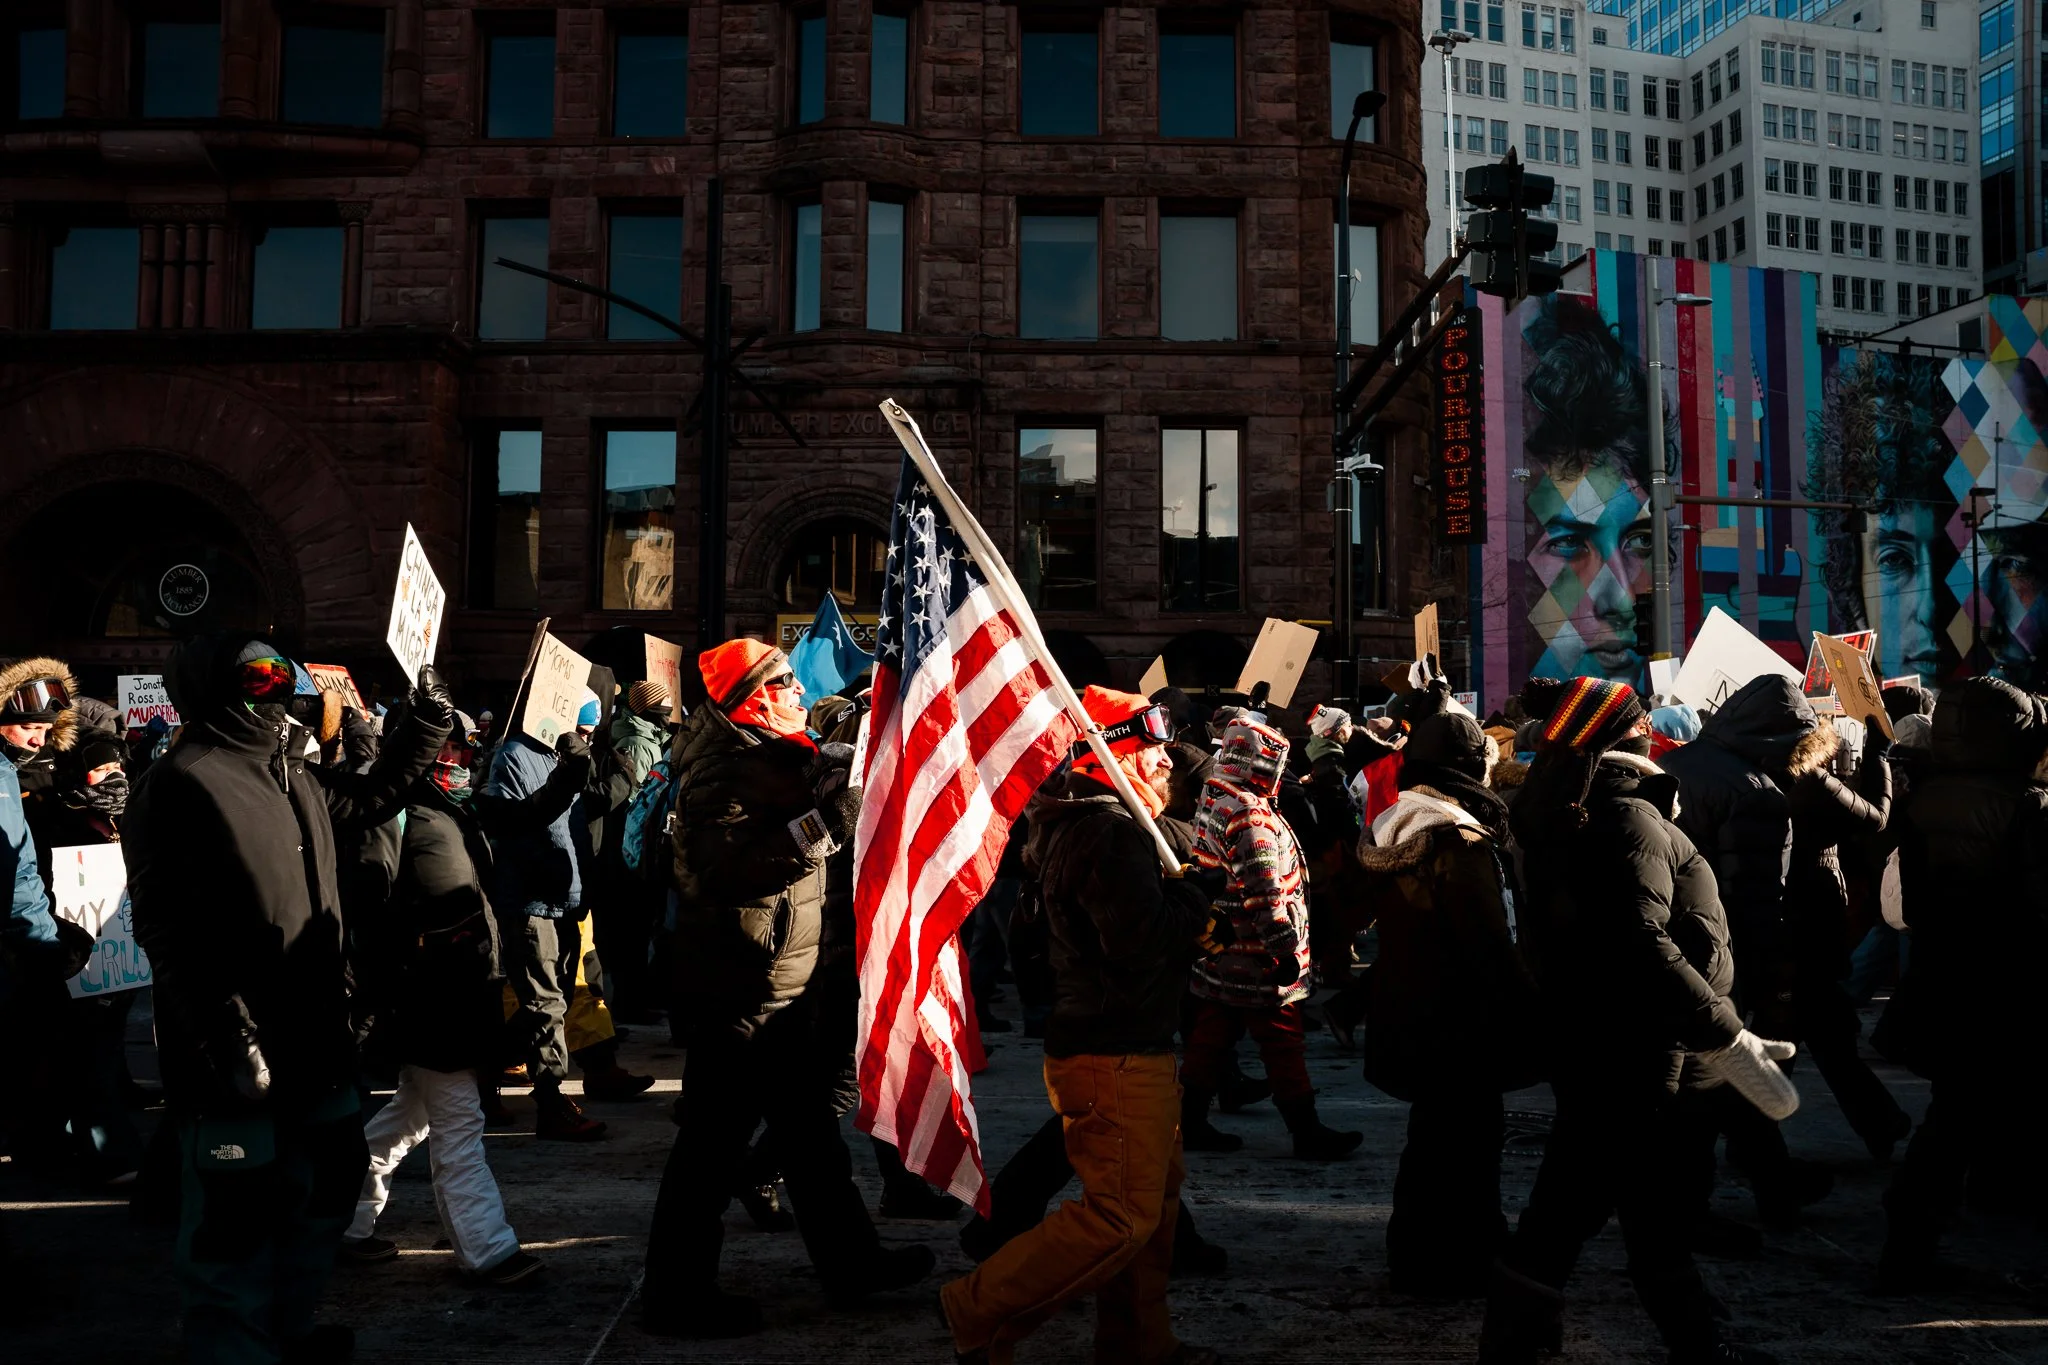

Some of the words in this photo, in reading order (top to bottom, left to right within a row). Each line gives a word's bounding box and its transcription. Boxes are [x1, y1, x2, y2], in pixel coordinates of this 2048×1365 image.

[729, 411, 821, 434] UMBER
[1440, 326, 1471, 535] POURHOUSE
[166, 568, 203, 584] LUMBER
[405, 539, 439, 622] CHINGA
[163, 592, 205, 612] EXCHANGE
[411, 589, 421, 622] LA
[395, 609, 427, 672] MIGRA
[128, 692, 154, 704] Ross
[157, 691, 165, 704] is
[313, 672, 365, 711] SHAME
[126, 704, 179, 725] MURDERER
[1101, 724, 1131, 740] MITH
[1837, 721, 1857, 747] NO
[63, 898, 106, 937] MY
[79, 939, 153, 993] CRUS
